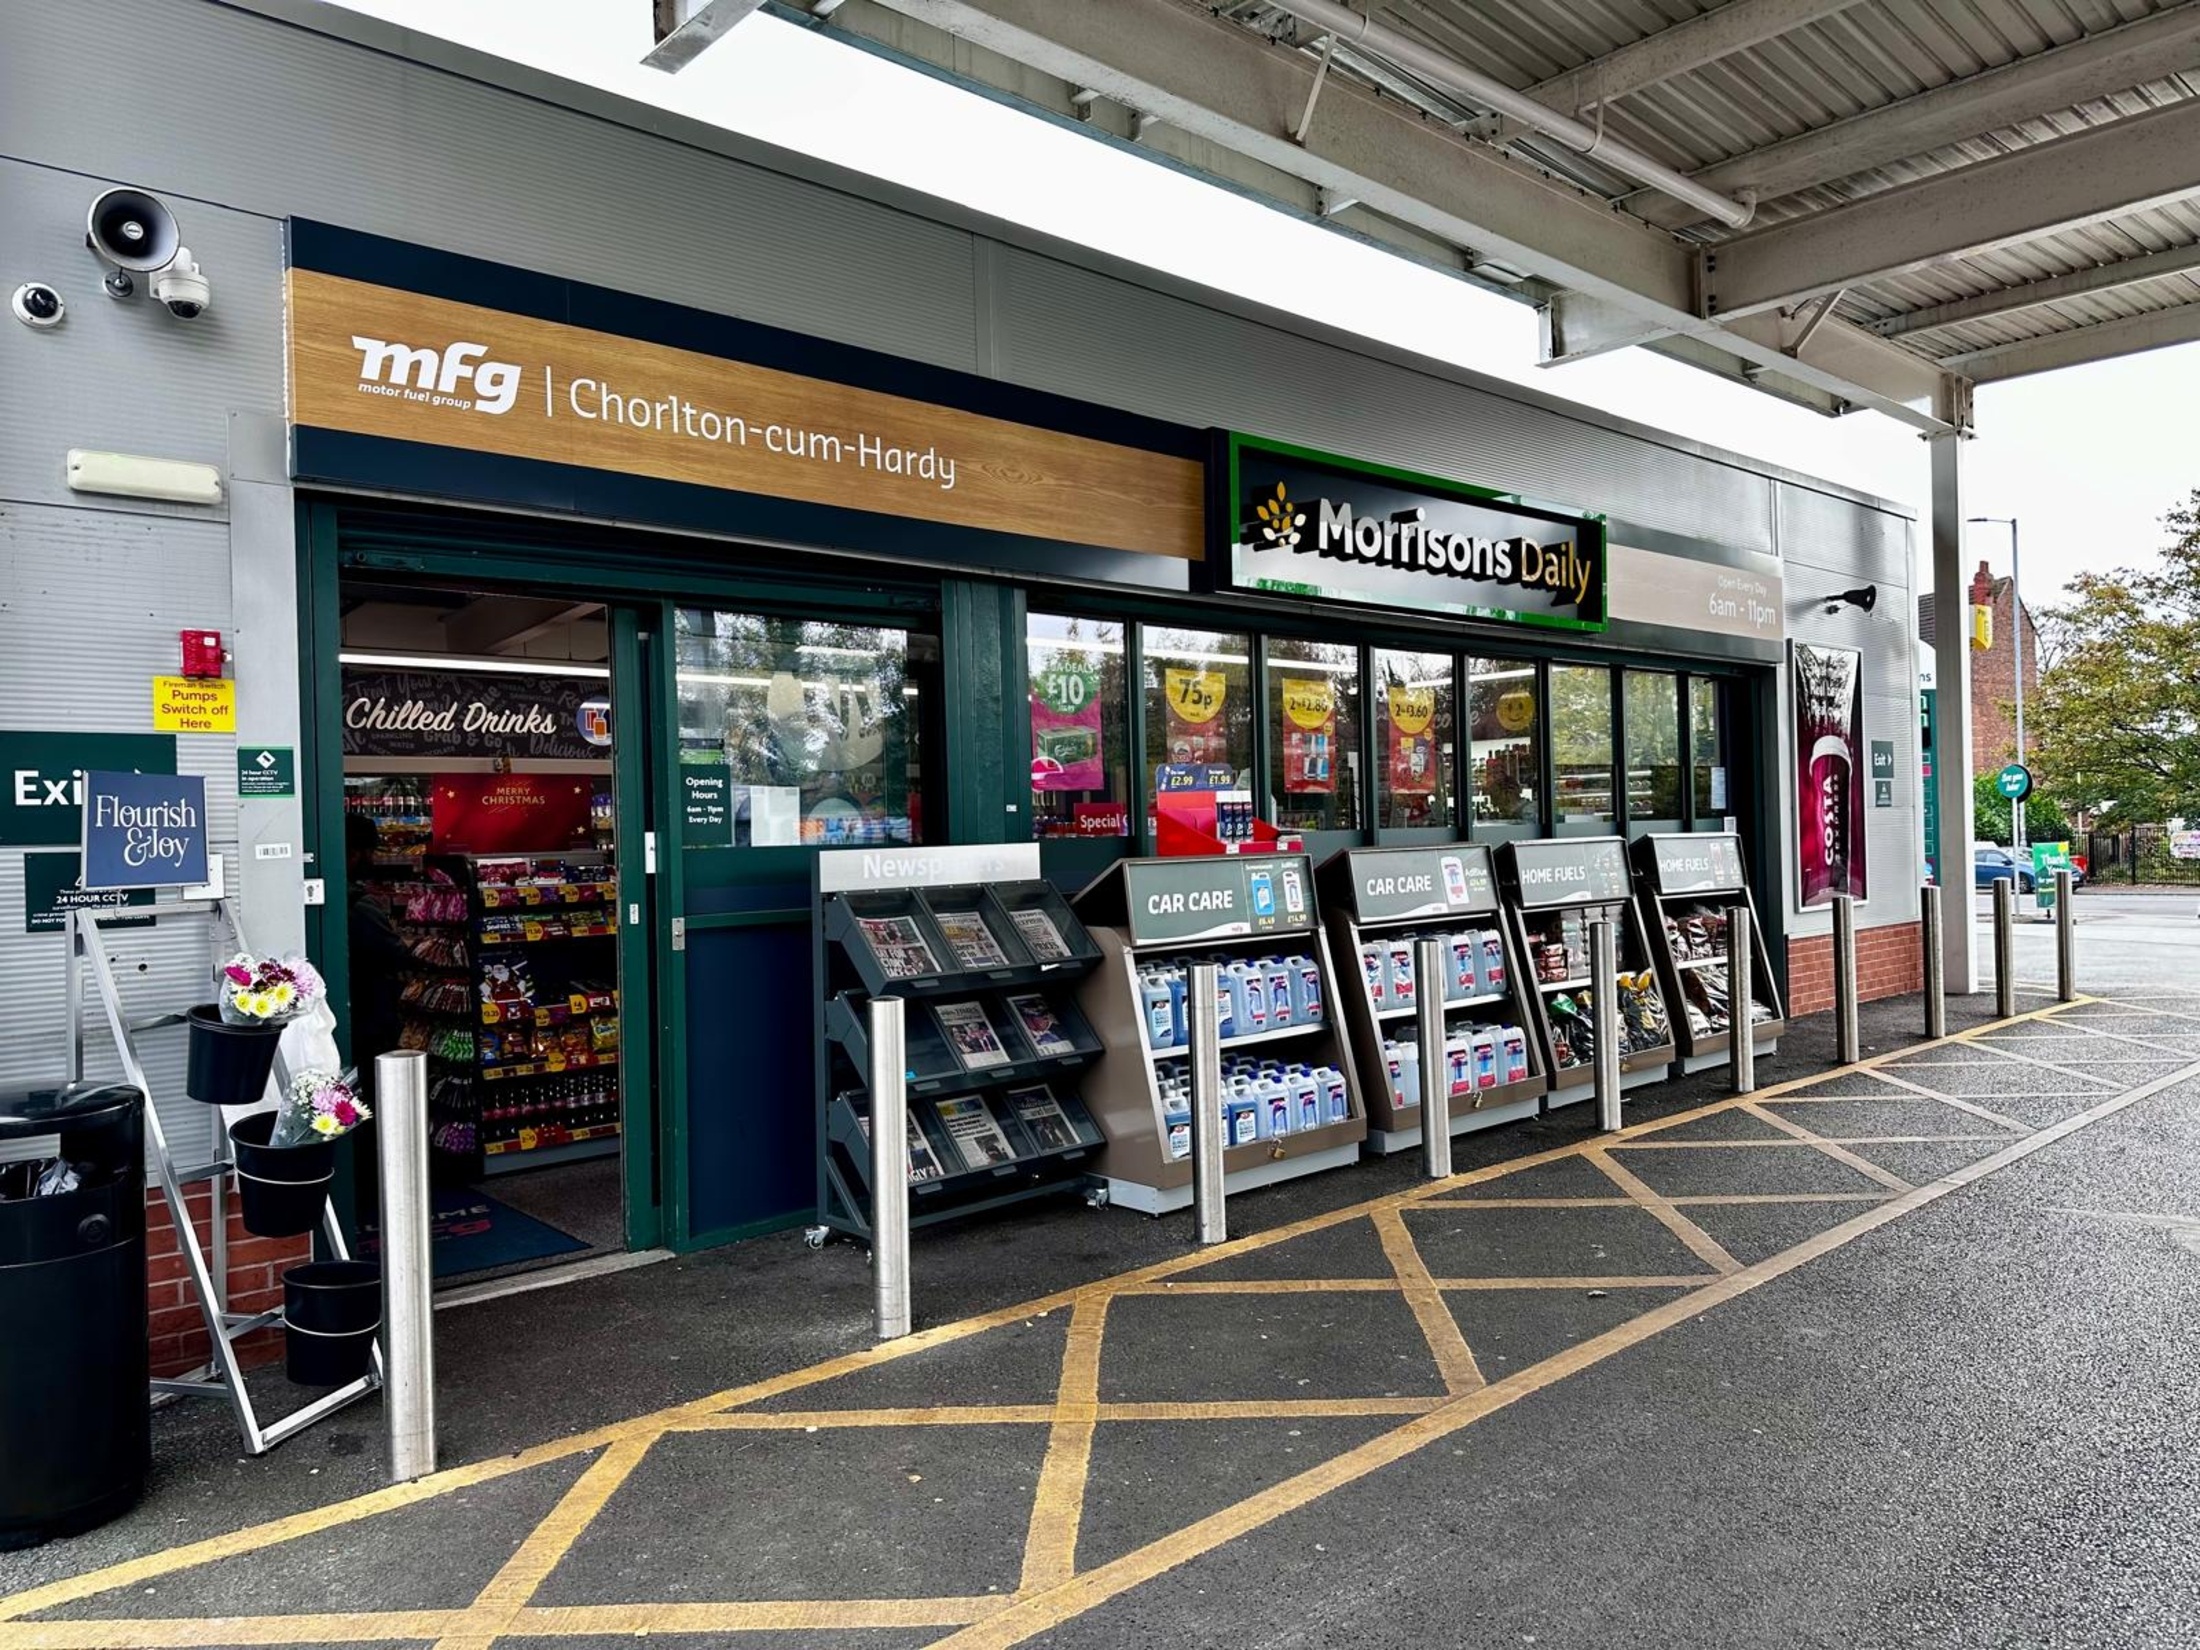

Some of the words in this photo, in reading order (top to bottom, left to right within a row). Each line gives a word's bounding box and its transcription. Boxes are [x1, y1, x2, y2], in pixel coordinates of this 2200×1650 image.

[352, 335, 521, 414] mfg
[358, 383, 401, 397] motor
[404, 388, 429, 402] fuel
[433, 393, 471, 410] group
[570, 378, 956, 489] Chorlton-cum-Hardy
[1318, 497, 1513, 579] Morrisons
[1521, 536, 1591, 604] Daily
[1755, 582, 1767, 598] Day
[1709, 592, 1736, 617] 6am
[1747, 598, 1776, 629] 11pm
[163, 681, 196, 689] Fireman
[1047, 674, 1085, 704] £10
[172, 690, 218, 702] Pumps
[1179, 678, 1213, 710] 75p
[161, 703, 207, 715] Switch
[211, 704, 229, 715] off
[346, 697, 459, 732] Chilled
[463, 702, 558, 735] Drinks
[180, 718, 212, 729] Here
[14, 769, 82, 806] Exi
[685, 777, 723, 788] Opening
[1170, 776, 1194, 786] £2.99
[1209, 775, 1231, 785] £1.99
[496, 787, 530, 795] MERRY
[691, 790, 718, 800] Hours
[481, 795, 546, 805] CHRISTMAS
[95, 794, 197, 828] Flourish
[686, 805, 702, 813] 6am
[688, 815, 708, 825] Every
[709, 815, 723, 825] Day
[1080, 815, 1120, 832] Special
[1822, 775, 1834, 866] COSTA
[1659, 858, 1684, 873] HOME
[1685, 857, 1709, 872] FUELS
[1521, 867, 1553, 884] HOME
[1555, 865, 1586, 882] FUELS
[1366, 878, 1395, 896] CAR
[1397, 875, 1432, 894] CARE
[56, 895, 68, 904] 24
[70, 894, 101, 903] HOUR
[1147, 893, 1185, 915] CAR
[1188, 889, 1233, 912] CARE
